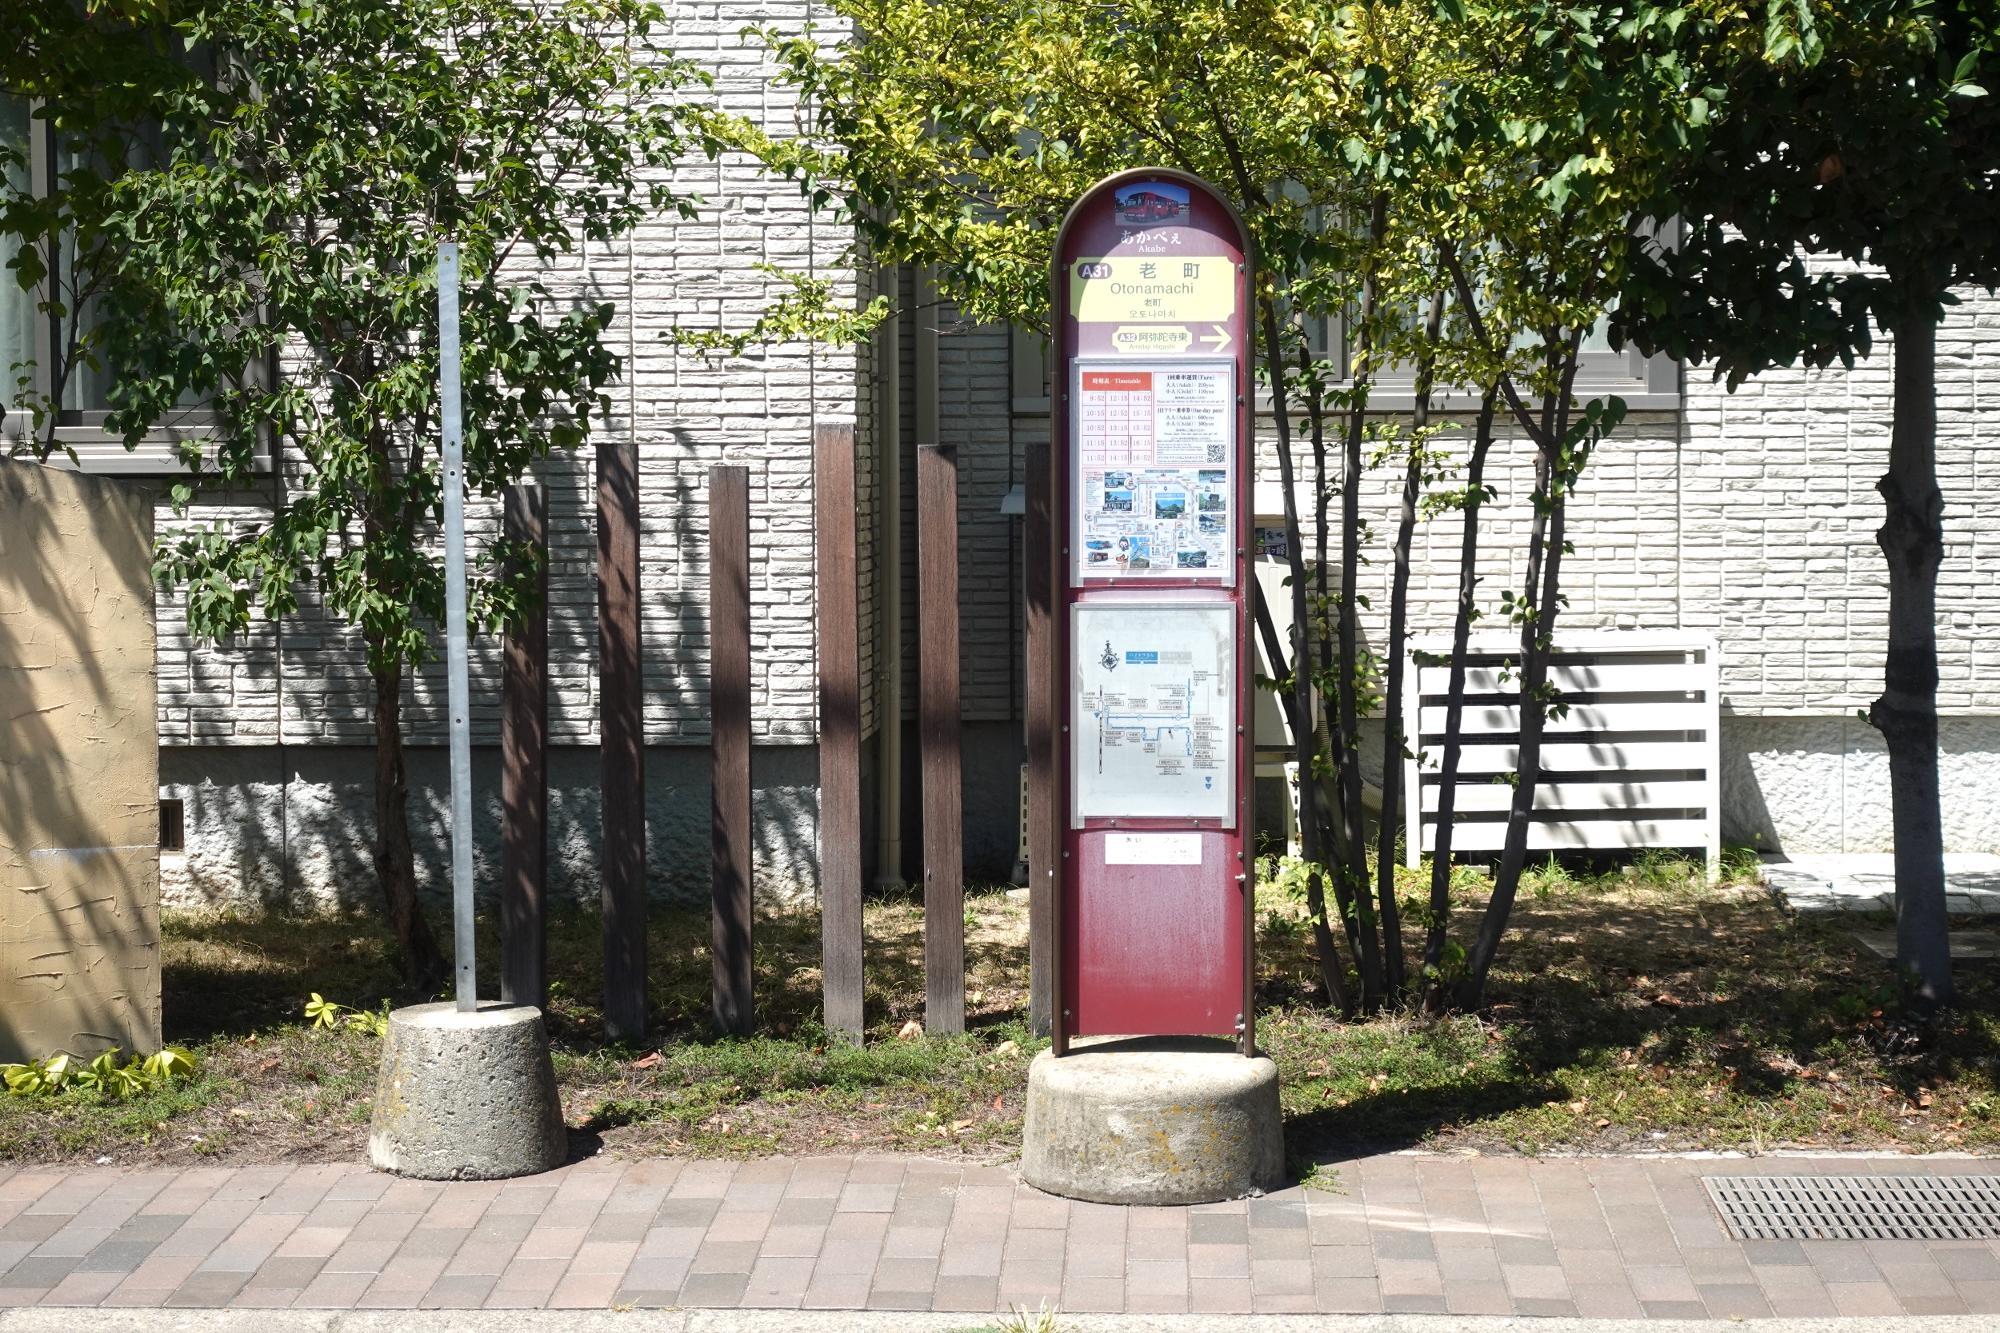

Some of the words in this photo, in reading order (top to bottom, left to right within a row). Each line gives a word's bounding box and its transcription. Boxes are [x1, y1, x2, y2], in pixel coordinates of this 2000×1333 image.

[1121, 230, 1182, 245] あかべぇ
[1081, 264, 1110, 278] A31
[1110, 282, 1194, 295] Otonamachi
[1119, 333, 1136, 341] A32
[1139, 332, 1187, 342] 阿弥陀寺東
